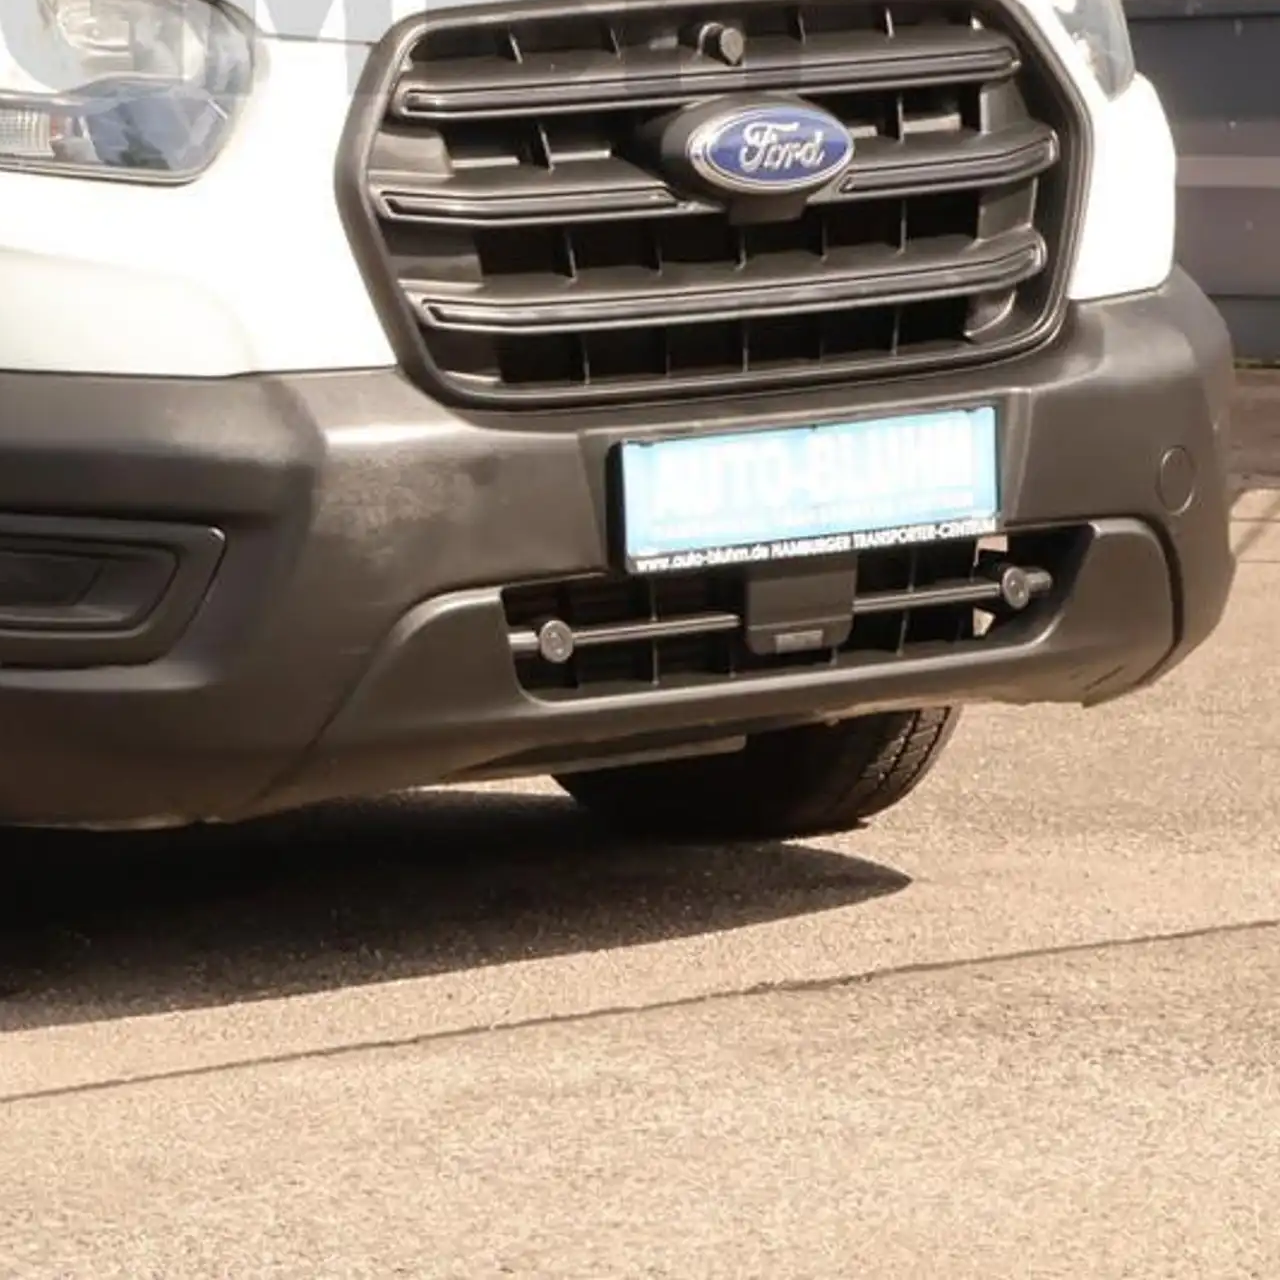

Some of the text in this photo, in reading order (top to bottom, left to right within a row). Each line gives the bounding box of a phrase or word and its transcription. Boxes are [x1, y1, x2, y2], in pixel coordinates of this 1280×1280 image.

[739, 120, 827, 172] Ford
[636, 544, 769, 573] www.auto-bluhm.de
[771, 532, 851, 560] HAMBURGER
